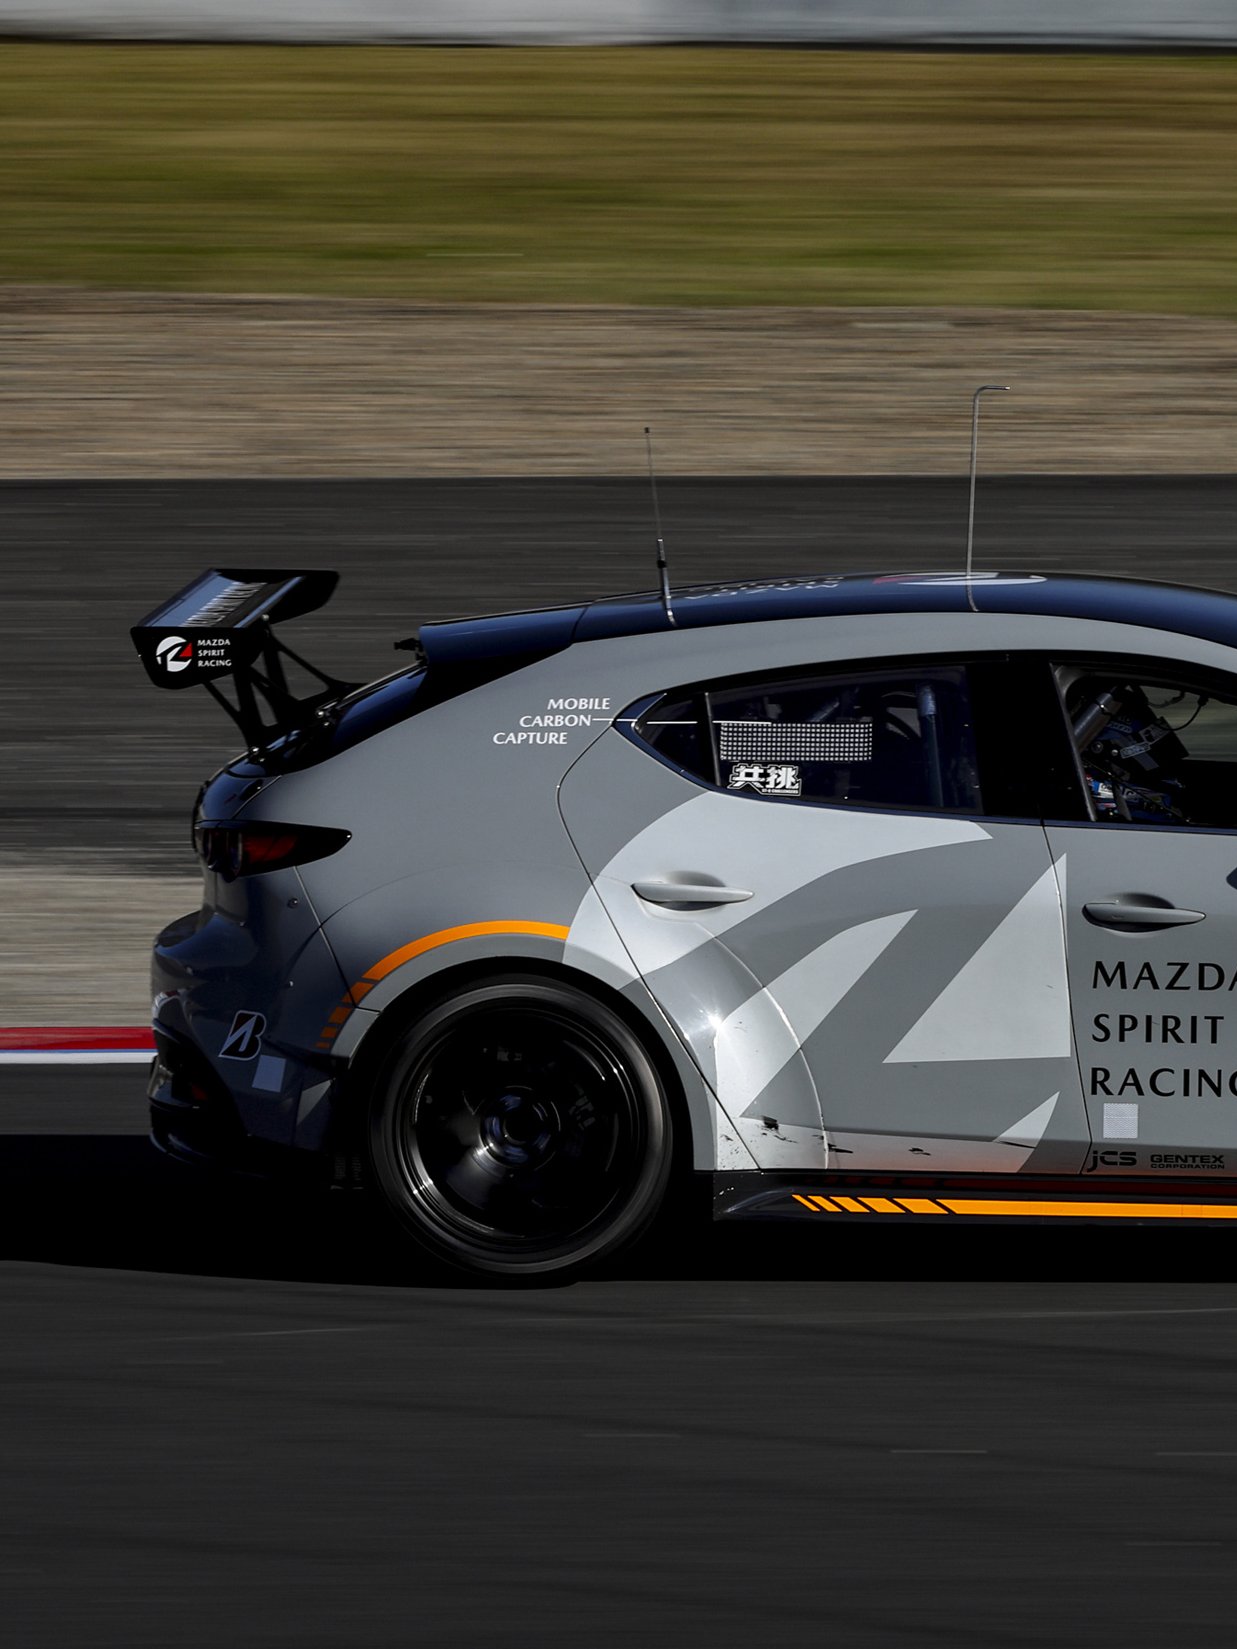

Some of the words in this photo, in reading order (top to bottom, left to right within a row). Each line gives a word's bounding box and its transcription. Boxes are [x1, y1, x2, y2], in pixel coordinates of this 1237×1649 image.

[197, 638, 231, 647] MAZDA
[197, 649, 225, 657] SPIRIT
[197, 659, 232, 667] RACING
[547, 698, 611, 710] MOBILE
[519, 714, 592, 727] CARBON
[492, 732, 568, 745] CAPTURE
[1092, 1013, 1225, 1044] SPIRIT
[1150, 1154, 1225, 1164] GENTEX
